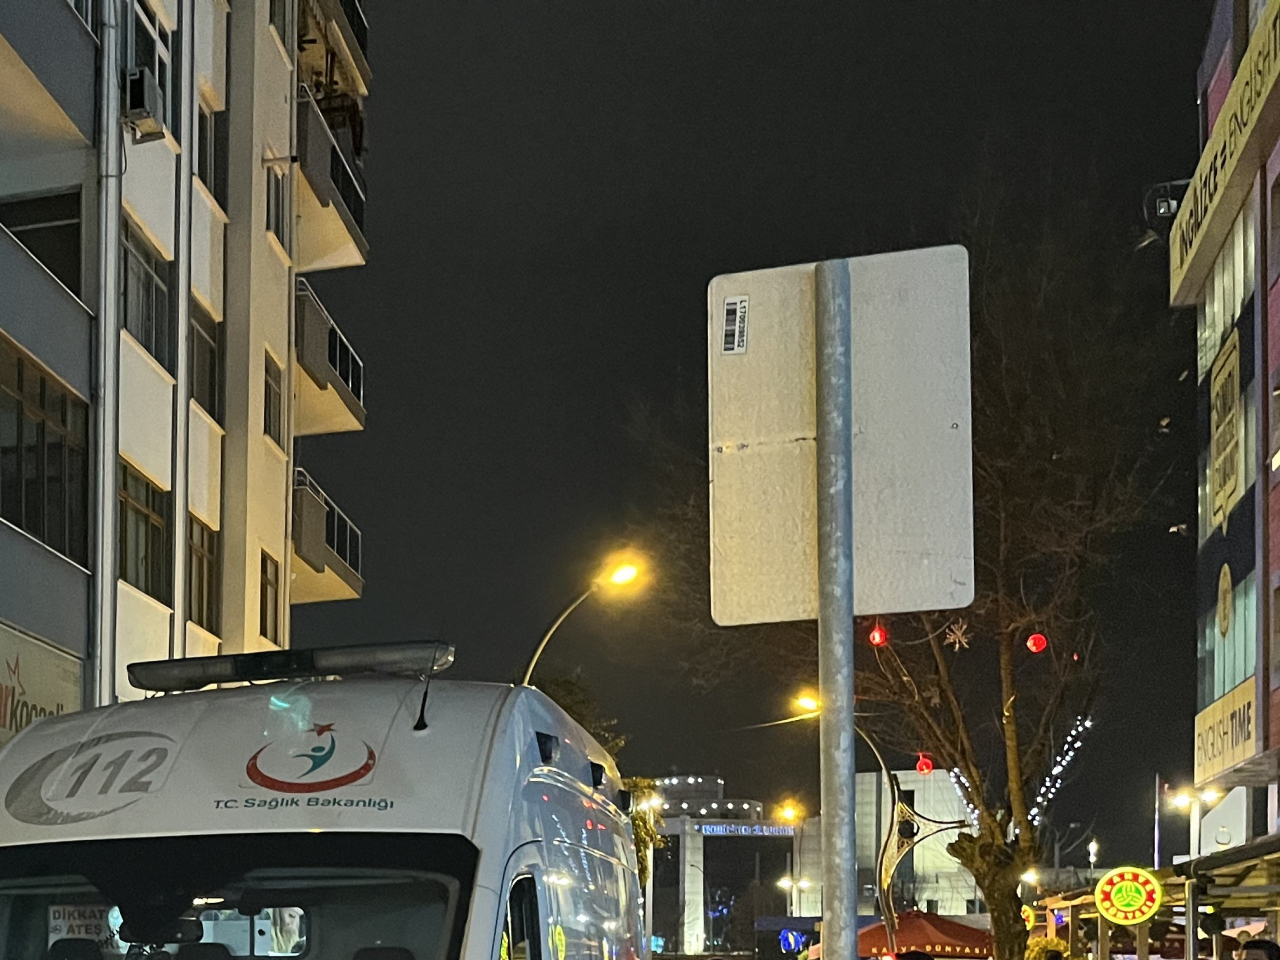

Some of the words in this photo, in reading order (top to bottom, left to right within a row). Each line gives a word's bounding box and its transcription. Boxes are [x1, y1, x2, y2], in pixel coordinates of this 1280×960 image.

[1230, 701, 1252, 750] TIME
[65, 747, 169, 799] 112
[243, 797, 300, 810] Sağlık
[306, 797, 394, 811] Bakanlığı
[53, 907, 106, 921] DİKKAT
